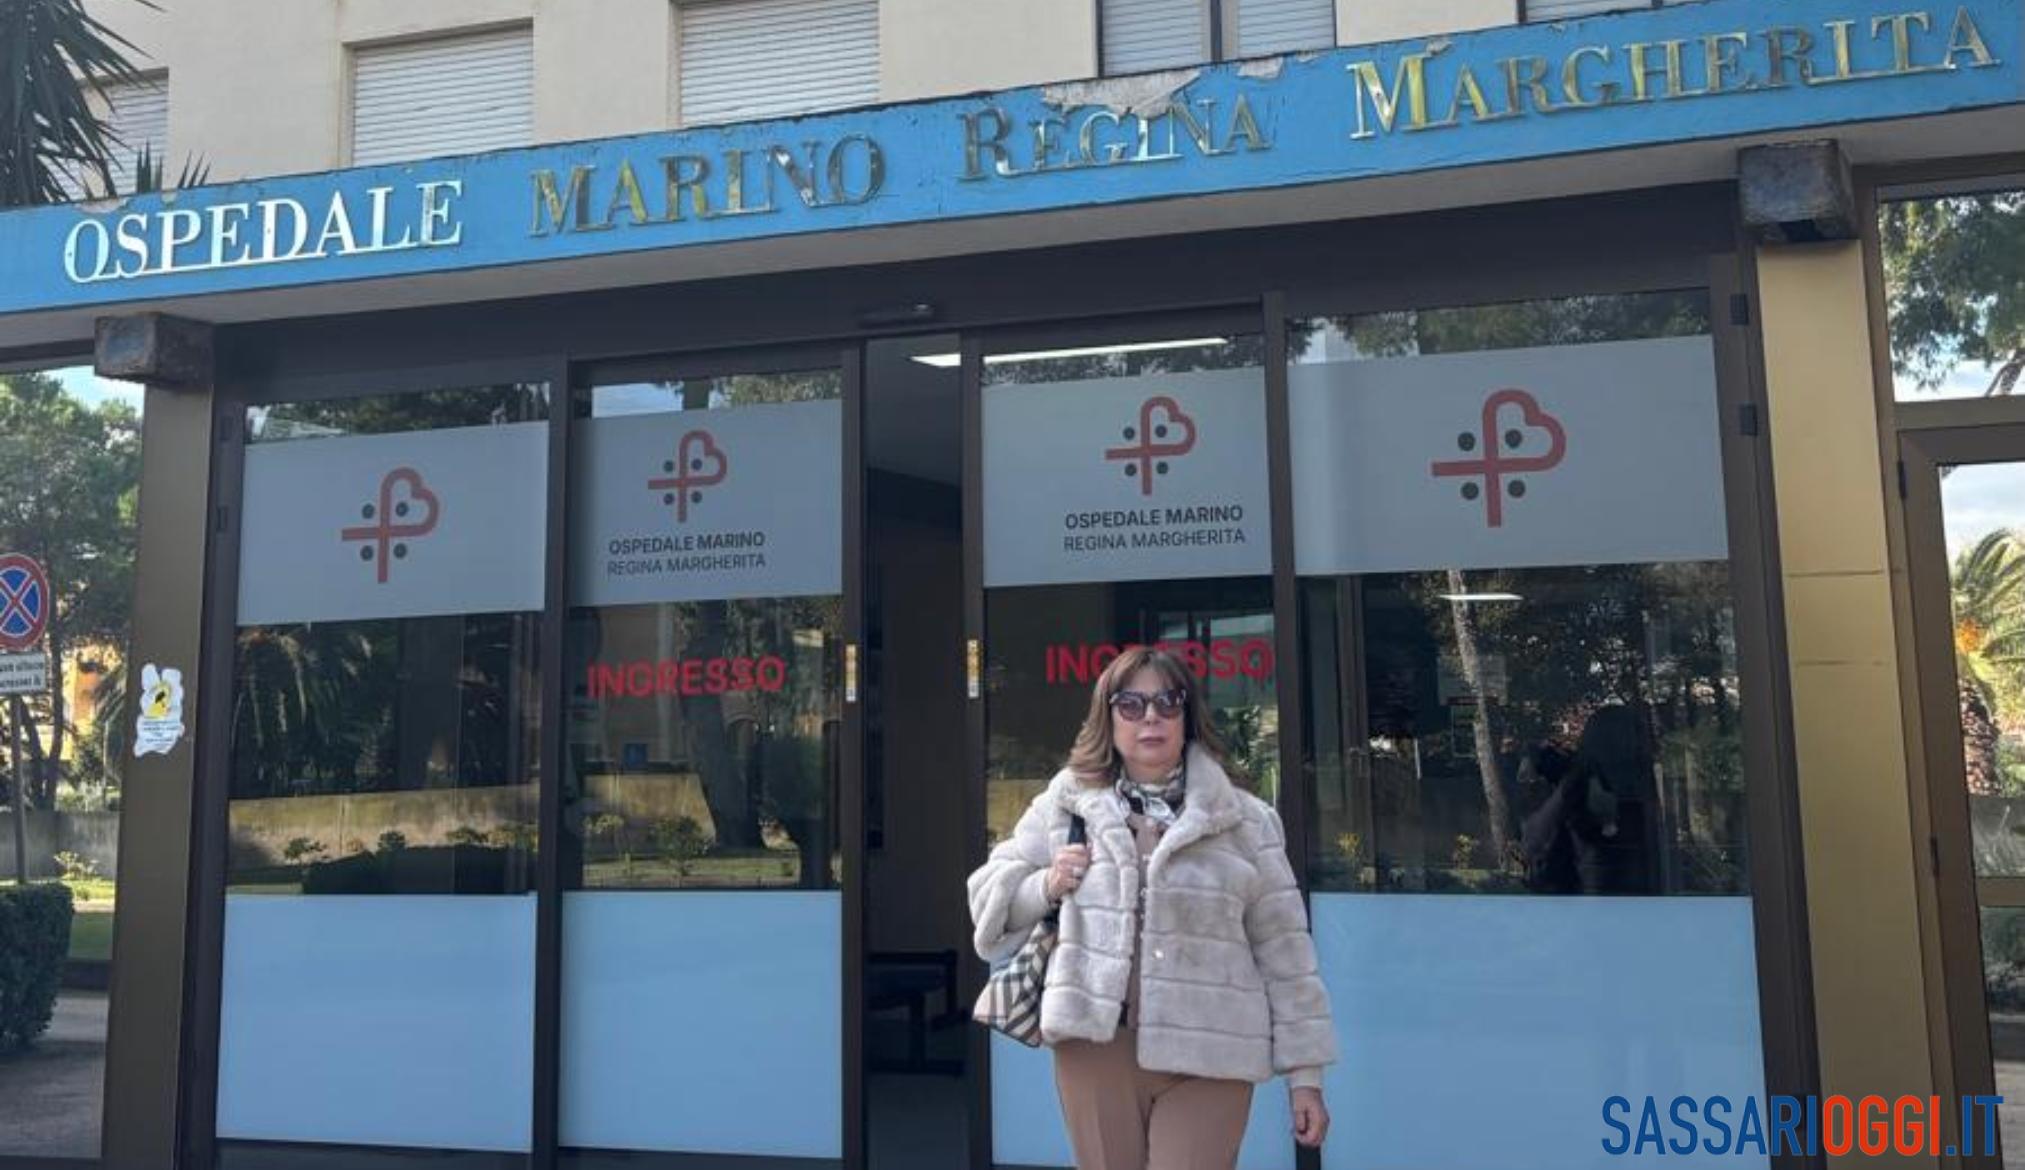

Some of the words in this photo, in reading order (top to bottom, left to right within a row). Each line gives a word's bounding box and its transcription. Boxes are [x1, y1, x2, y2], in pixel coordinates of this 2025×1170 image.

[64, 180, 463, 283] OSPEDALE
[529, 132, 886, 237] MARINO
[956, 95, 1272, 181] REGINA
[1346, 5, 2001, 140] MARGHERITA
[1065, 507, 1160, 530] OSPEDALE
[1165, 505, 1243, 524] MARINO
[608, 536, 694, 555] OSPEDALE
[697, 531, 765, 550] MARINO
[1064, 533, 1127, 552] REGINA
[1132, 529, 1246, 549] MARGHERITA
[607, 559, 662, 577] REGINA
[666, 553, 766, 573] MARGHERITA
[587, 655, 787, 698] INGRESSO
